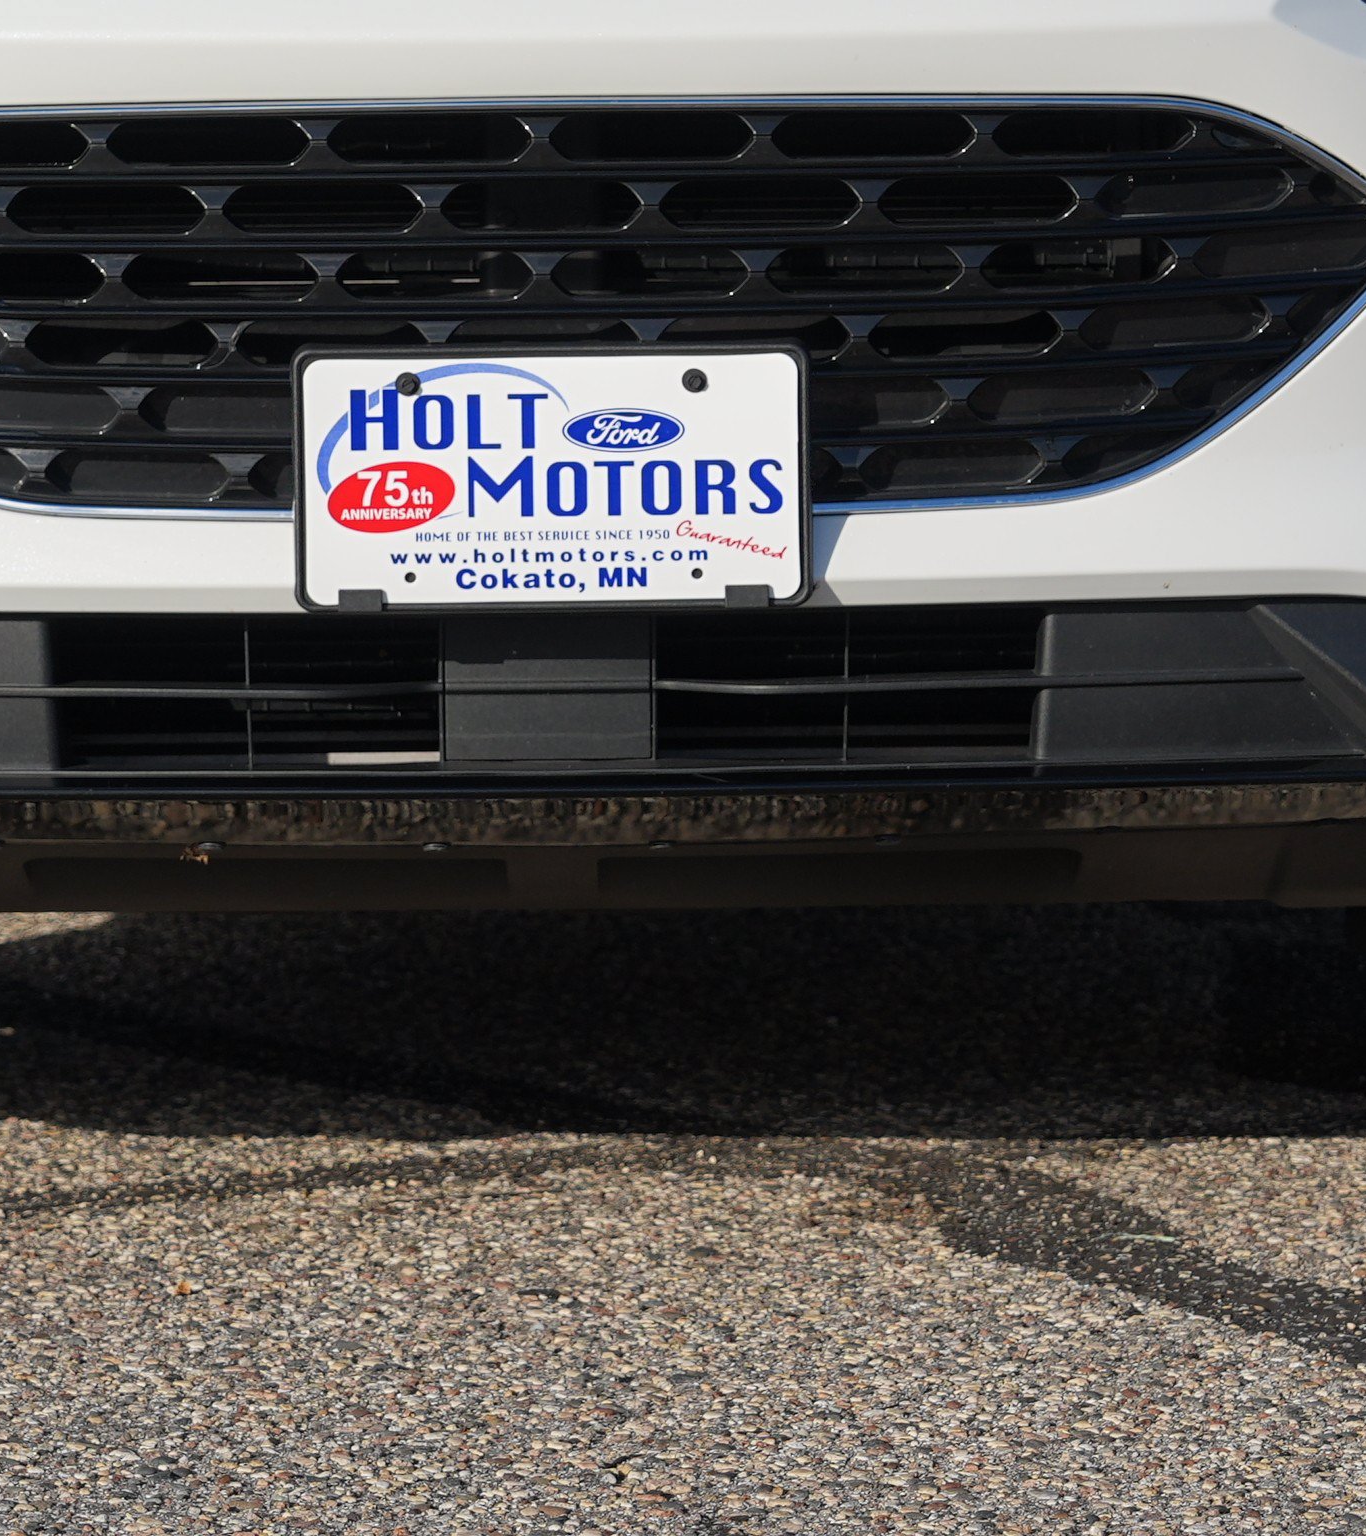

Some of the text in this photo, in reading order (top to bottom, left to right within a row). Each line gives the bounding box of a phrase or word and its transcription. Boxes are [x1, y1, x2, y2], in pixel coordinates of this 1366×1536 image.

[349, 389, 549, 451] HOLT
[585, 413, 661, 445] Ford
[356, 470, 434, 507] 75th
[467, 455, 784, 517] MOTORS
[340, 507, 433, 521] ANNIVERSARY
[415, 529, 671, 543] HOME OF THE BEST SERVICE SINCE 1950
[676, 520, 788, 560] Guaranteed
[390, 548, 709, 565] www.holtmotors.com
[455, 567, 648, 593] Cokato, MN
